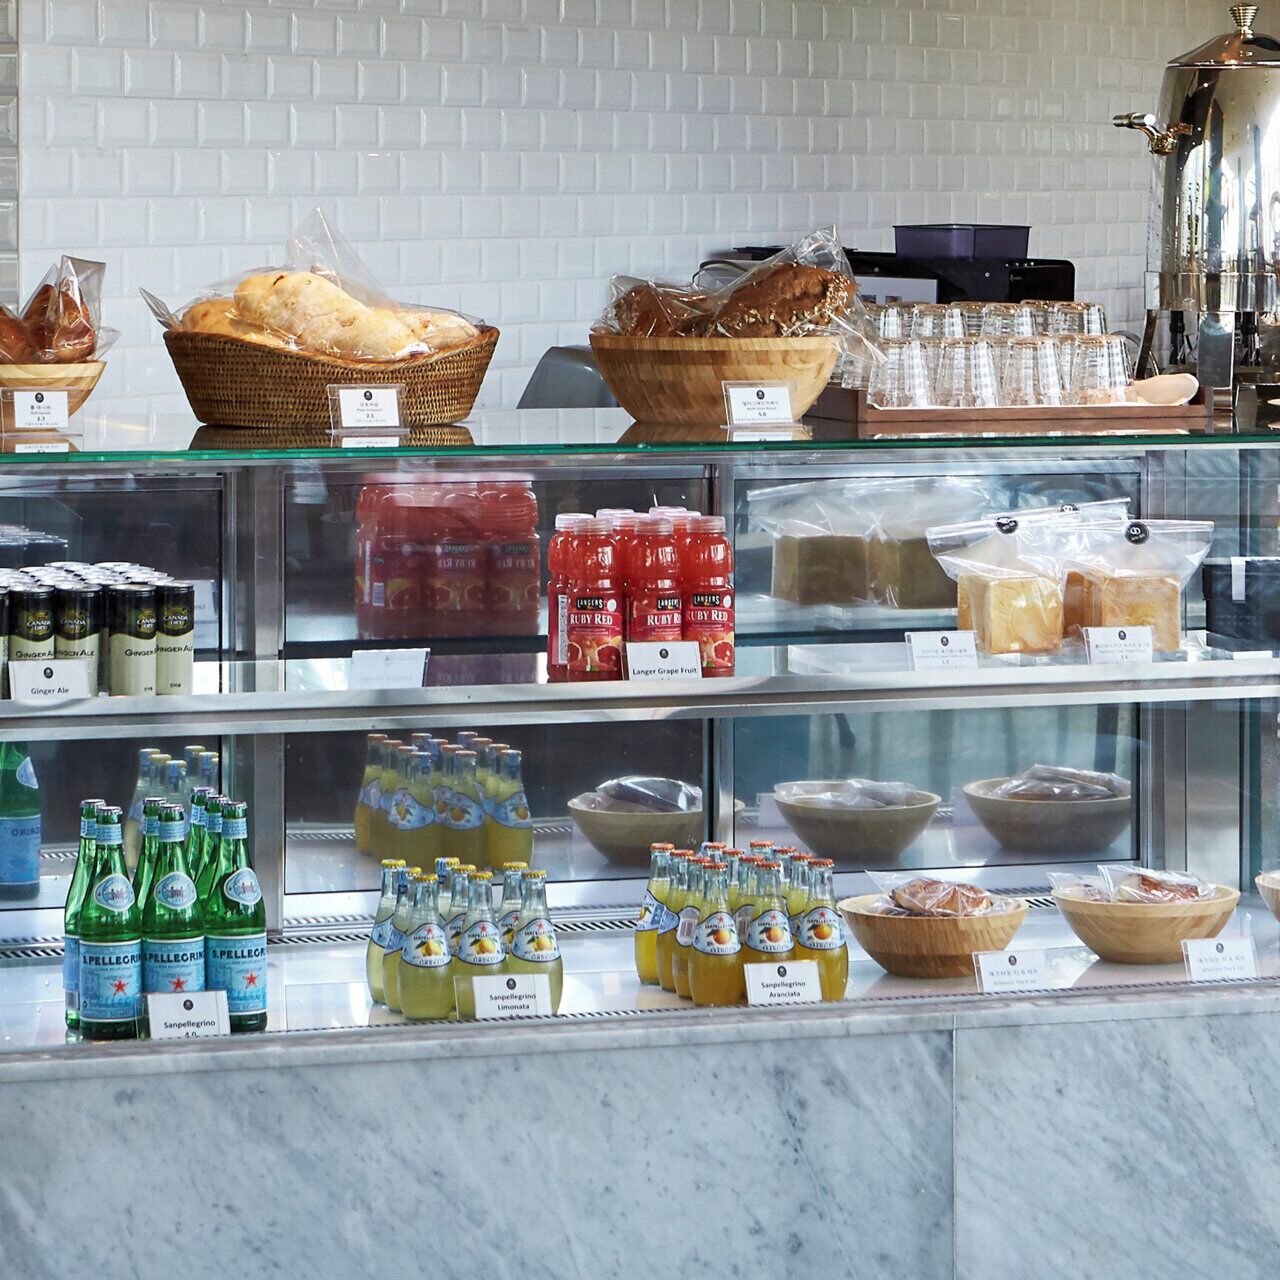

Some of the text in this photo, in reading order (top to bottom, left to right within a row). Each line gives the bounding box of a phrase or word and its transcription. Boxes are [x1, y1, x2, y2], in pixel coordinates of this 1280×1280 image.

[577, 598, 604, 609] LANGERS
[693, 594, 720, 605] LANGERS
[570, 614, 613, 625] RUBY RED
[648, 615, 670, 625] RUBY
[686, 610, 728, 621] RUBY RED
[657, 668, 679, 676] Grape
[681, 667, 697, 675] Fruit
[31, 687, 55, 696] Ginger
[760, 981, 806, 990] Sanpellegrino
[489, 993, 537, 1002] Sanpellegrino
[163, 1020, 216, 1030] Sanpellegrino
